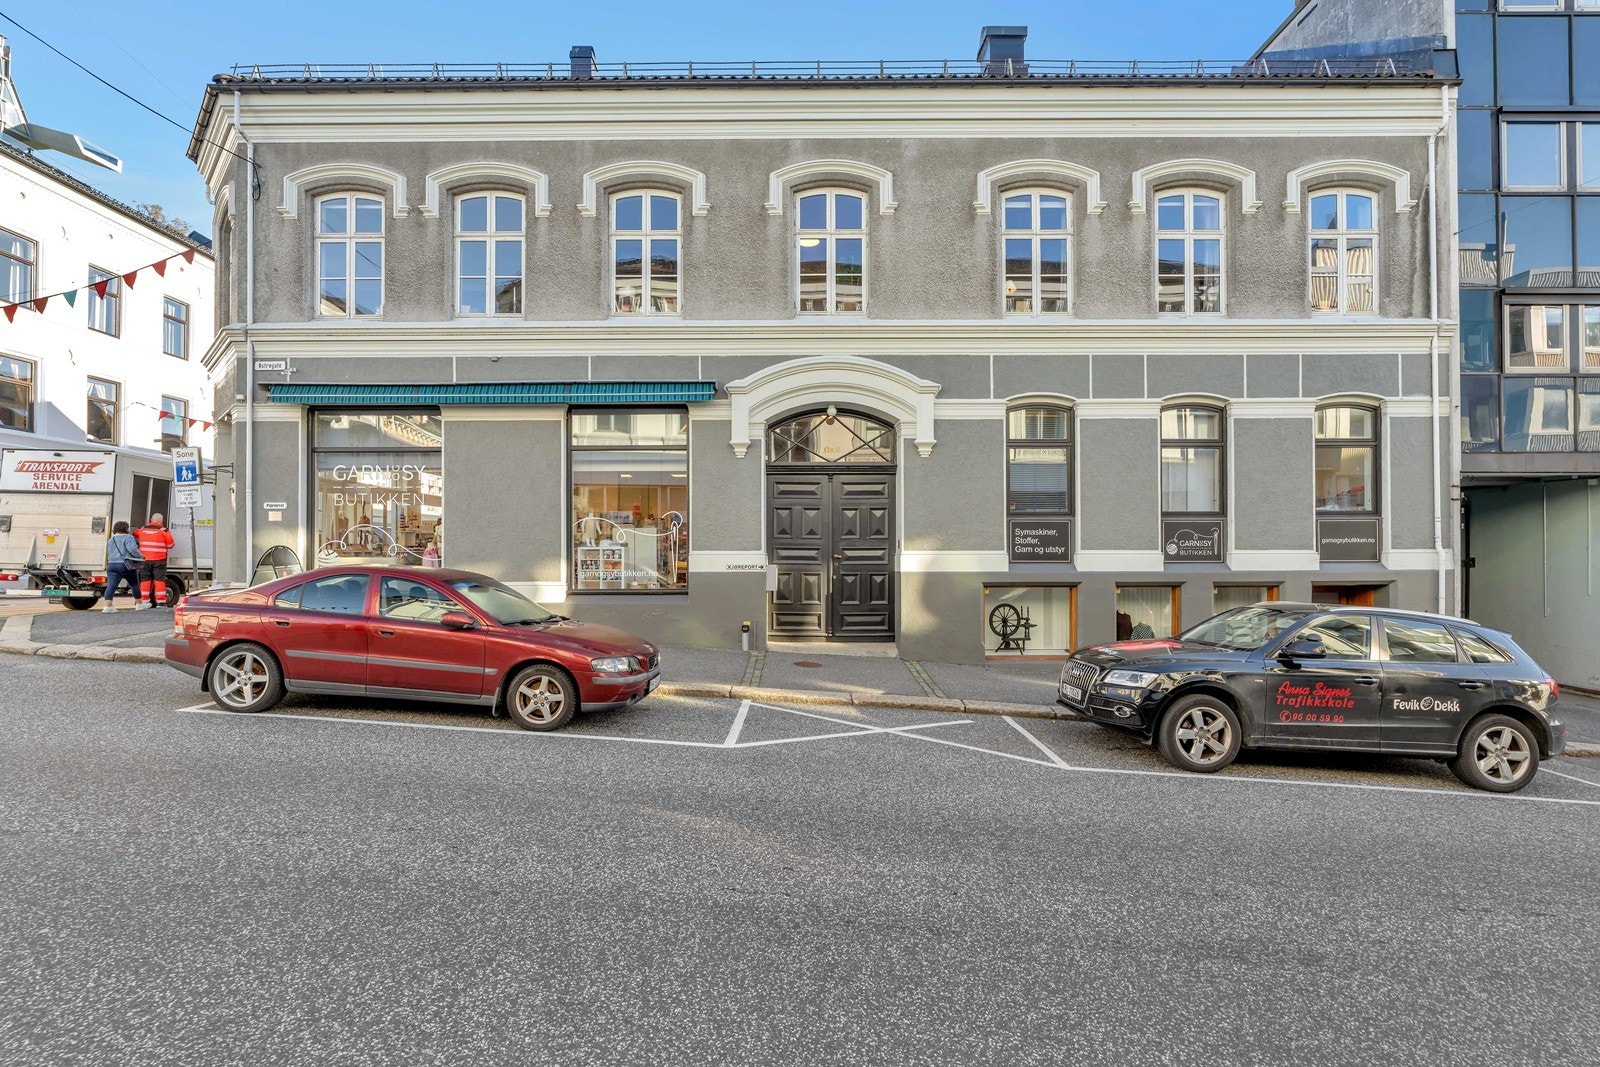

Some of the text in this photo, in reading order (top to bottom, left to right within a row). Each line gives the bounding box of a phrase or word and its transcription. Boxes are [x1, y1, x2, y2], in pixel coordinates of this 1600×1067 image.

[33, 473, 82, 481] SERVICE
[32, 482, 82, 490] ARENDAL
[334, 492, 425, 506] BUTIKKEN
[1015, 528, 1058, 536] Symaskiner,
[1015, 537, 1040, 545] Stoffer,
[1045, 546, 1066, 554] utstyr
[580, 570, 658, 579] garnogsybutikken.no
[1278, 680, 1352, 699] Anna Signes
[1276, 695, 1355, 708] Trafikkskole
[1393, 699, 1420, 710] Fevik
[1434, 700, 1460, 712] Dekk
[1292, 712, 1344, 723] 95 00 59 90
